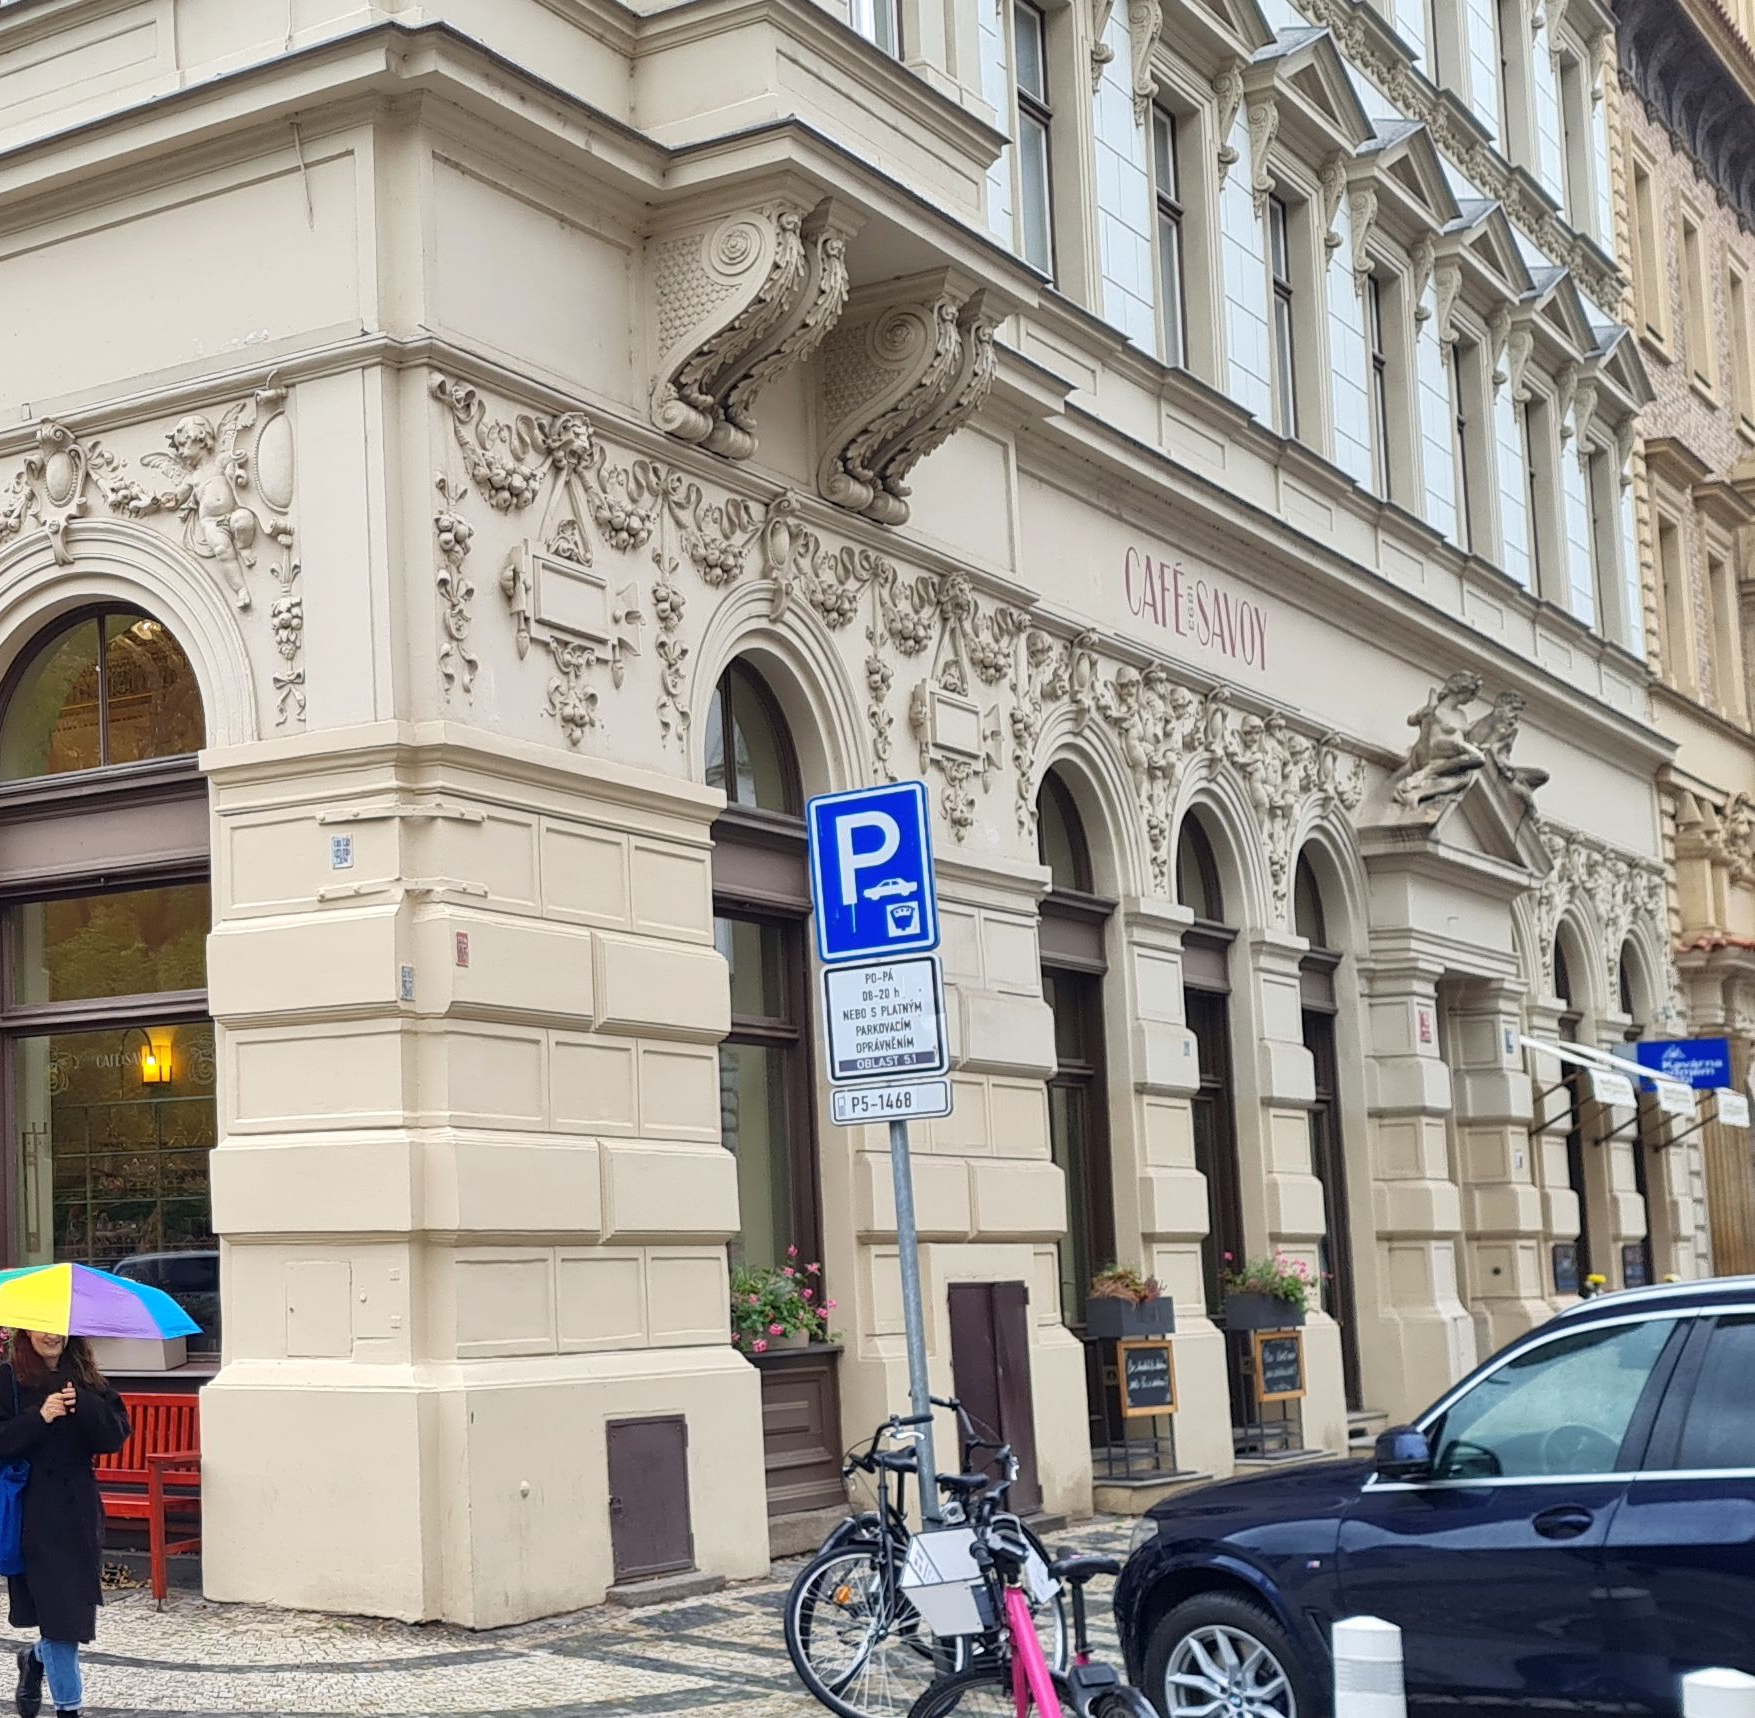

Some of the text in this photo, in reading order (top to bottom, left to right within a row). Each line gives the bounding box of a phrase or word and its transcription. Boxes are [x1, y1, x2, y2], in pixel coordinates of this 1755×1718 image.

[1125, 546, 1187, 637] CAFÉ
[1196, 580, 1267, 671] SAVOY
[836, 811, 900, 905] P
[865, 968, 894, 984] PO-PÁ
[862, 987, 900, 1001] 08-20 h
[843, 999, 922, 1021] NEBO S PLATNÝM
[856, 1018, 912, 1036] PARKOVACÍM
[856, 1035, 914, 1053] OPRÁVNĚNÍM
[857, 1053, 916, 1069] OBLAST 5.1
[852, 1092, 912, 1113] P5-1468
